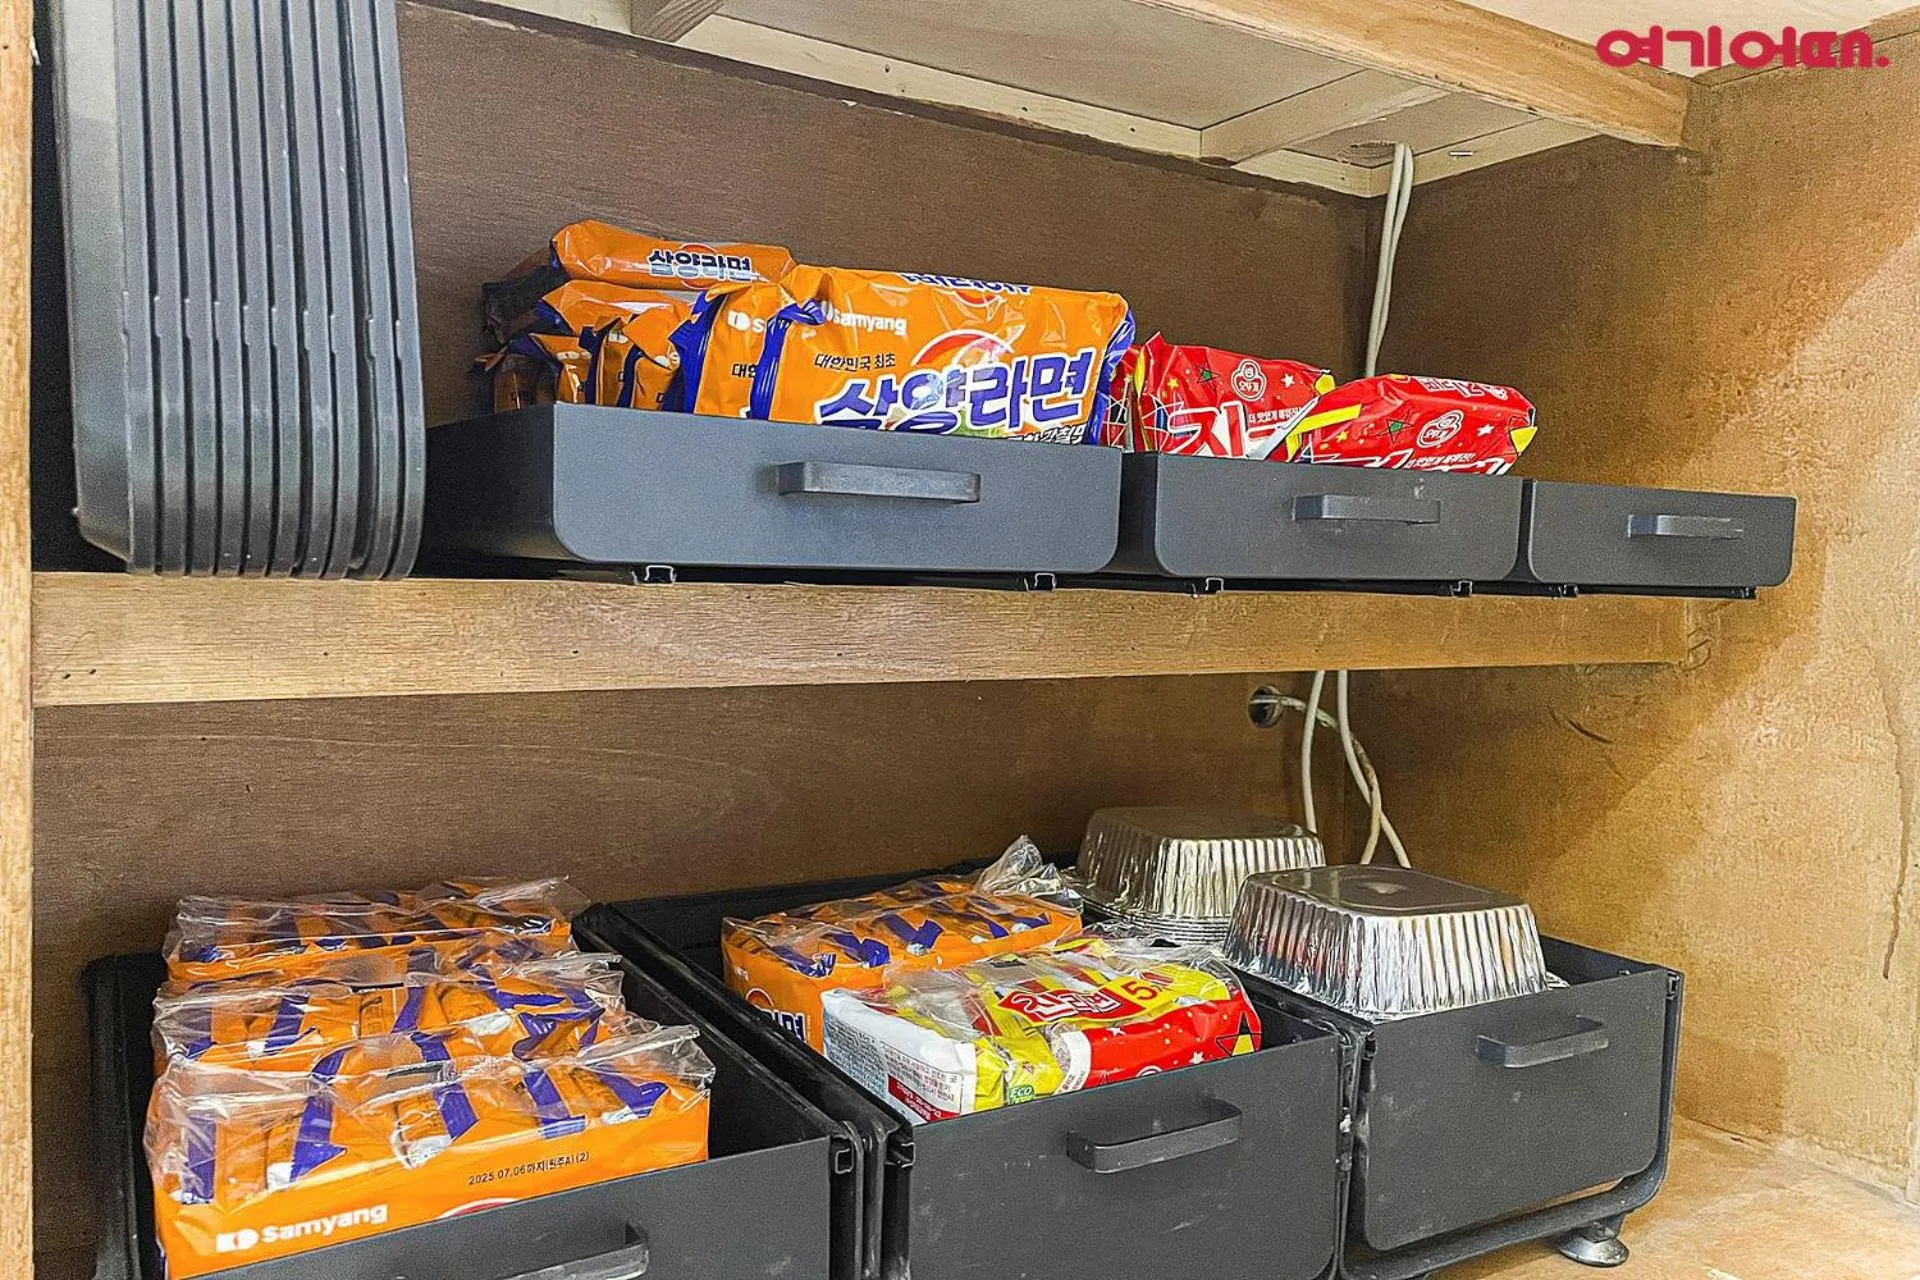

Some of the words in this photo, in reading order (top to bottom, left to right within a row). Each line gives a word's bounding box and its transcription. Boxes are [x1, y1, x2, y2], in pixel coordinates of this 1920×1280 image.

[648, 249, 753, 282] 삼양라면
[814, 353, 872, 372] 대한민국
[874, 352, 896, 370] 최초
[814, 347, 1096, 435] 삼양라면
[1010, 990, 1124, 1022] 진라면
[261, 1203, 389, 1244] Samyang
